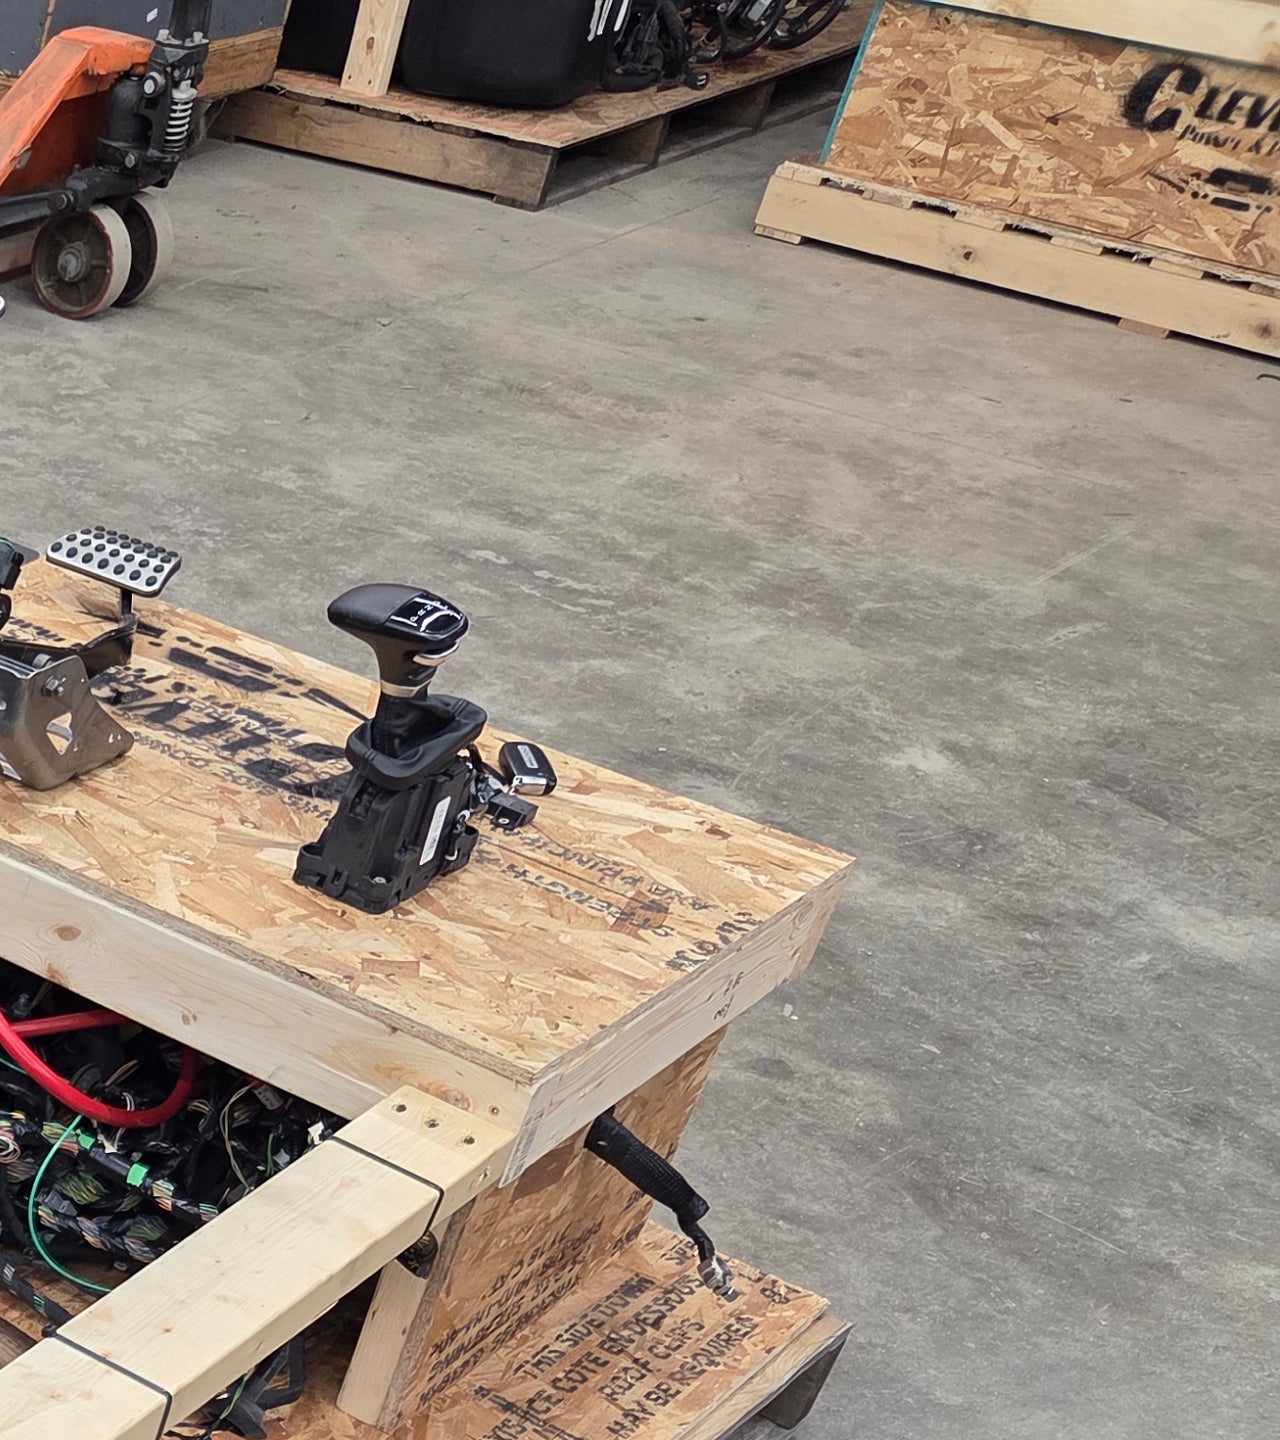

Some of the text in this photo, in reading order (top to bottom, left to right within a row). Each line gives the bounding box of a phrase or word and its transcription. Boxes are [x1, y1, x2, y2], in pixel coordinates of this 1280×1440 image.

[512, 1344, 567, 1382] THIS
[554, 1313, 606, 1349] SIDE
[592, 1272, 656, 1318] DOWN
[597, 1316, 707, 1400] ROOF CLIPS
